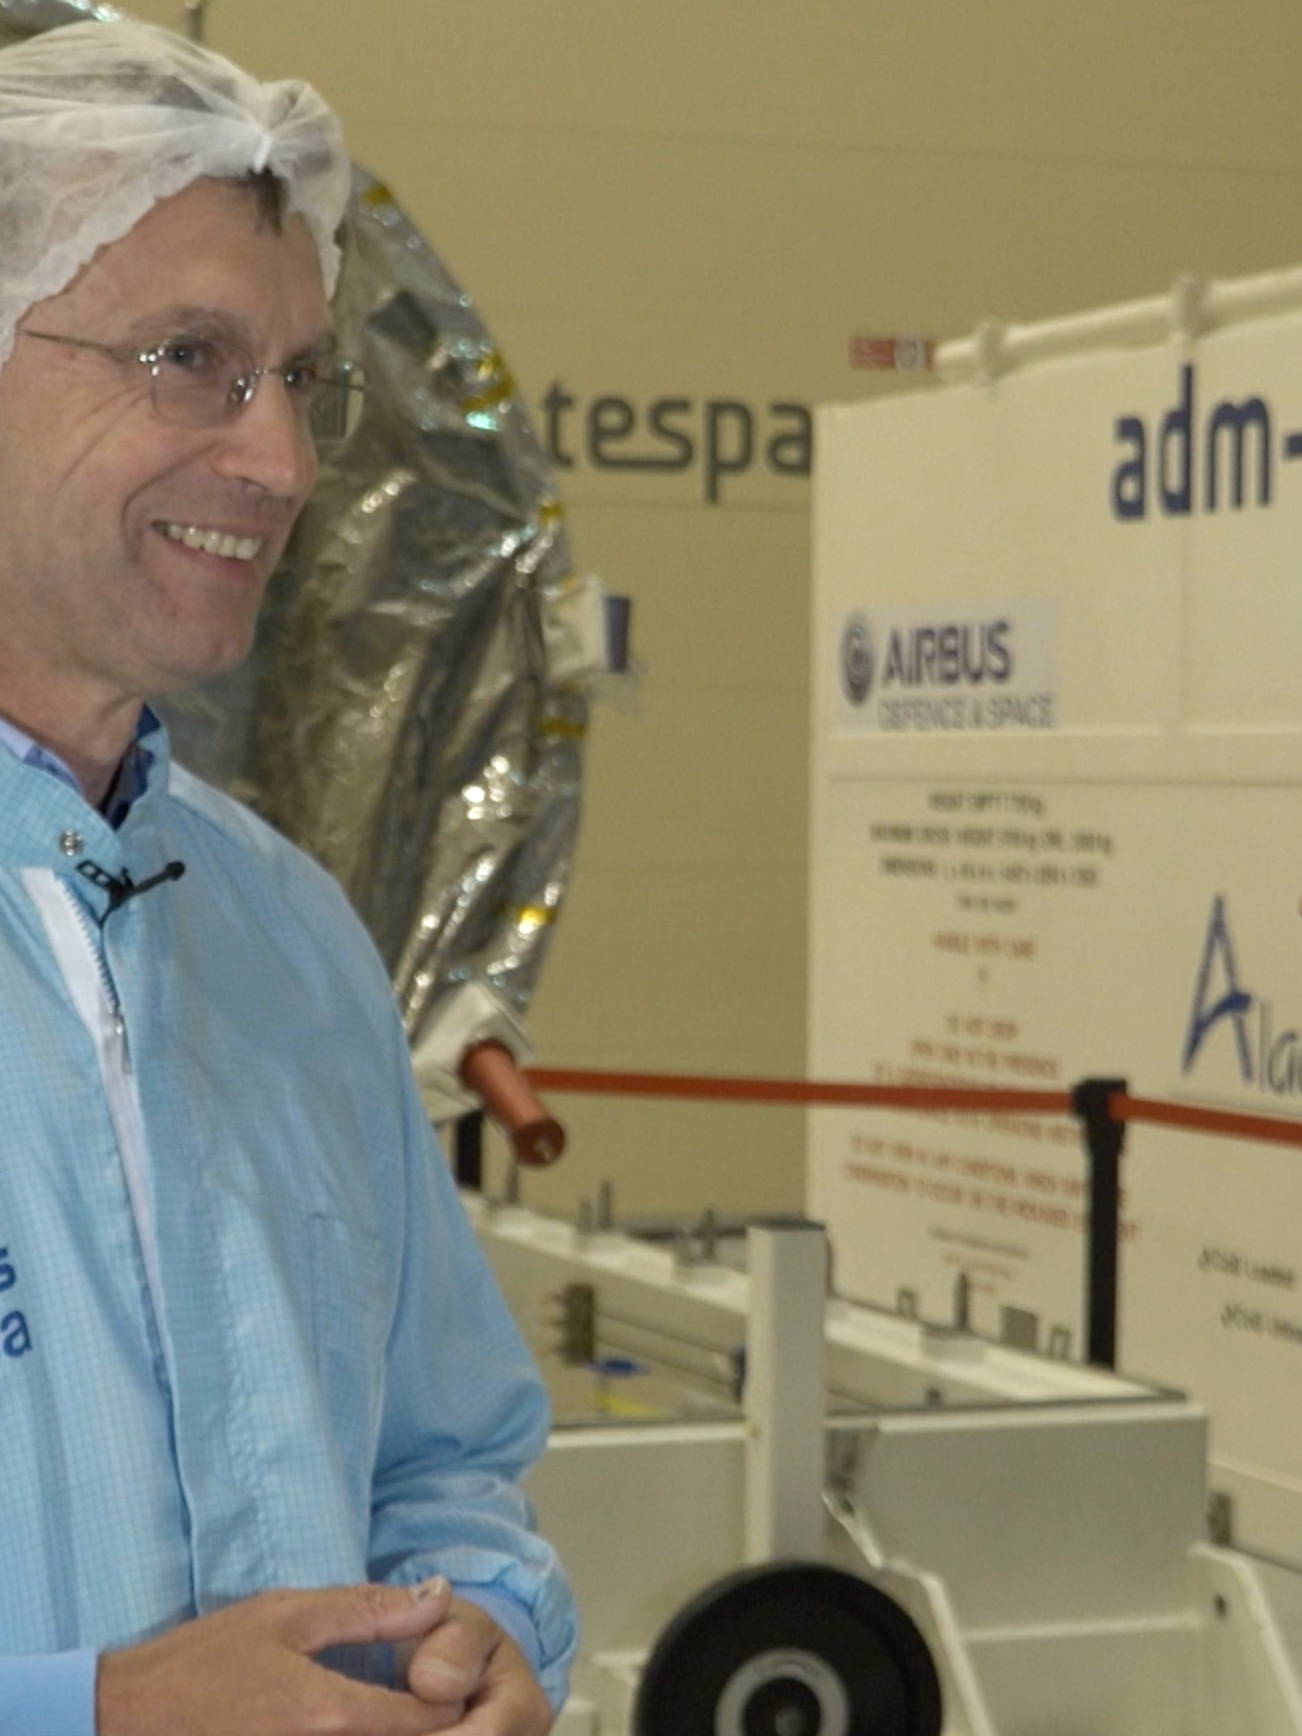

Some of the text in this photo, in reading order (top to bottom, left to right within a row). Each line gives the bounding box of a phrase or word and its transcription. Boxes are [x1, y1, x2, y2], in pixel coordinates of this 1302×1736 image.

[543, 380, 812, 506] tespa
[881, 620, 1013, 688] AIRBUS
[878, 697, 966, 731] DEFENCE
[987, 693, 1056, 730] SPACE
